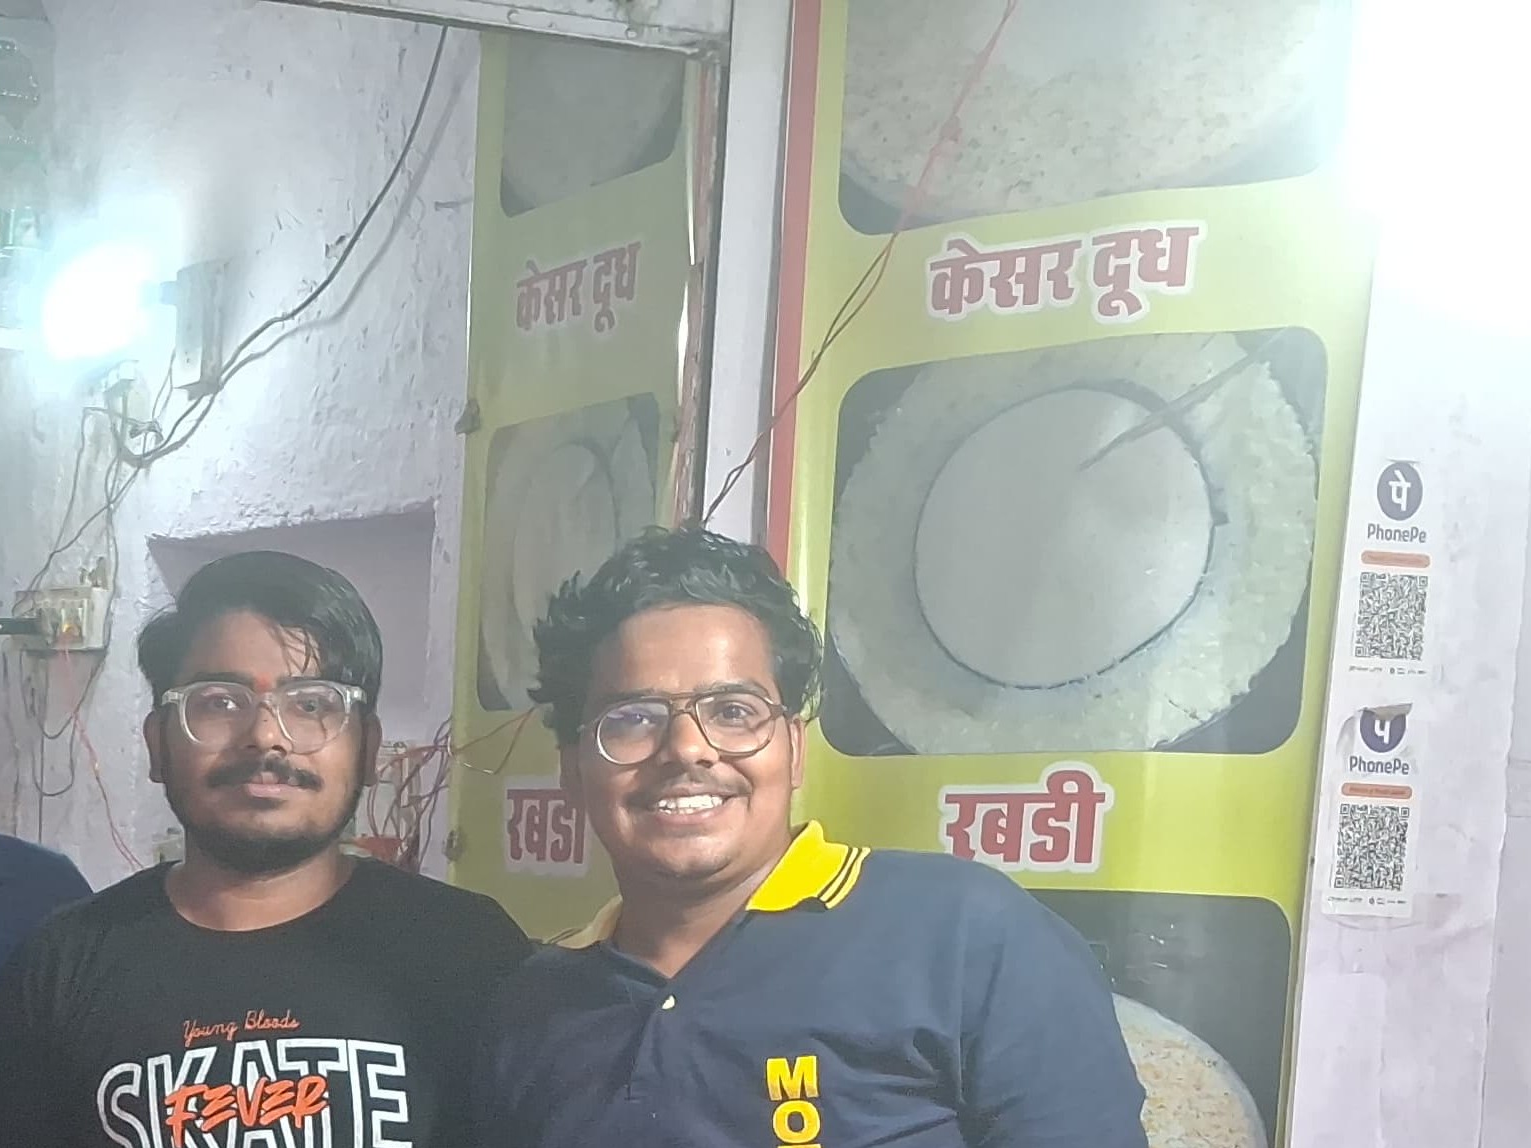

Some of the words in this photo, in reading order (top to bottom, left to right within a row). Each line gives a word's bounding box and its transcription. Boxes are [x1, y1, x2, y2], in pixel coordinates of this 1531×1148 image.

[517, 259, 588, 331] केसर
[592, 241, 642, 333] दूध
[930, 238, 1083, 315] केसर
[1092, 226, 1199, 316] दूध
[1367, 523, 1427, 543] PhonePe
[1349, 755, 1410, 776] PhonePe
[945, 770, 1106, 864] रबडी
[182, 1018, 238, 1048] Young
[164, 1075, 329, 1148] FEVER
